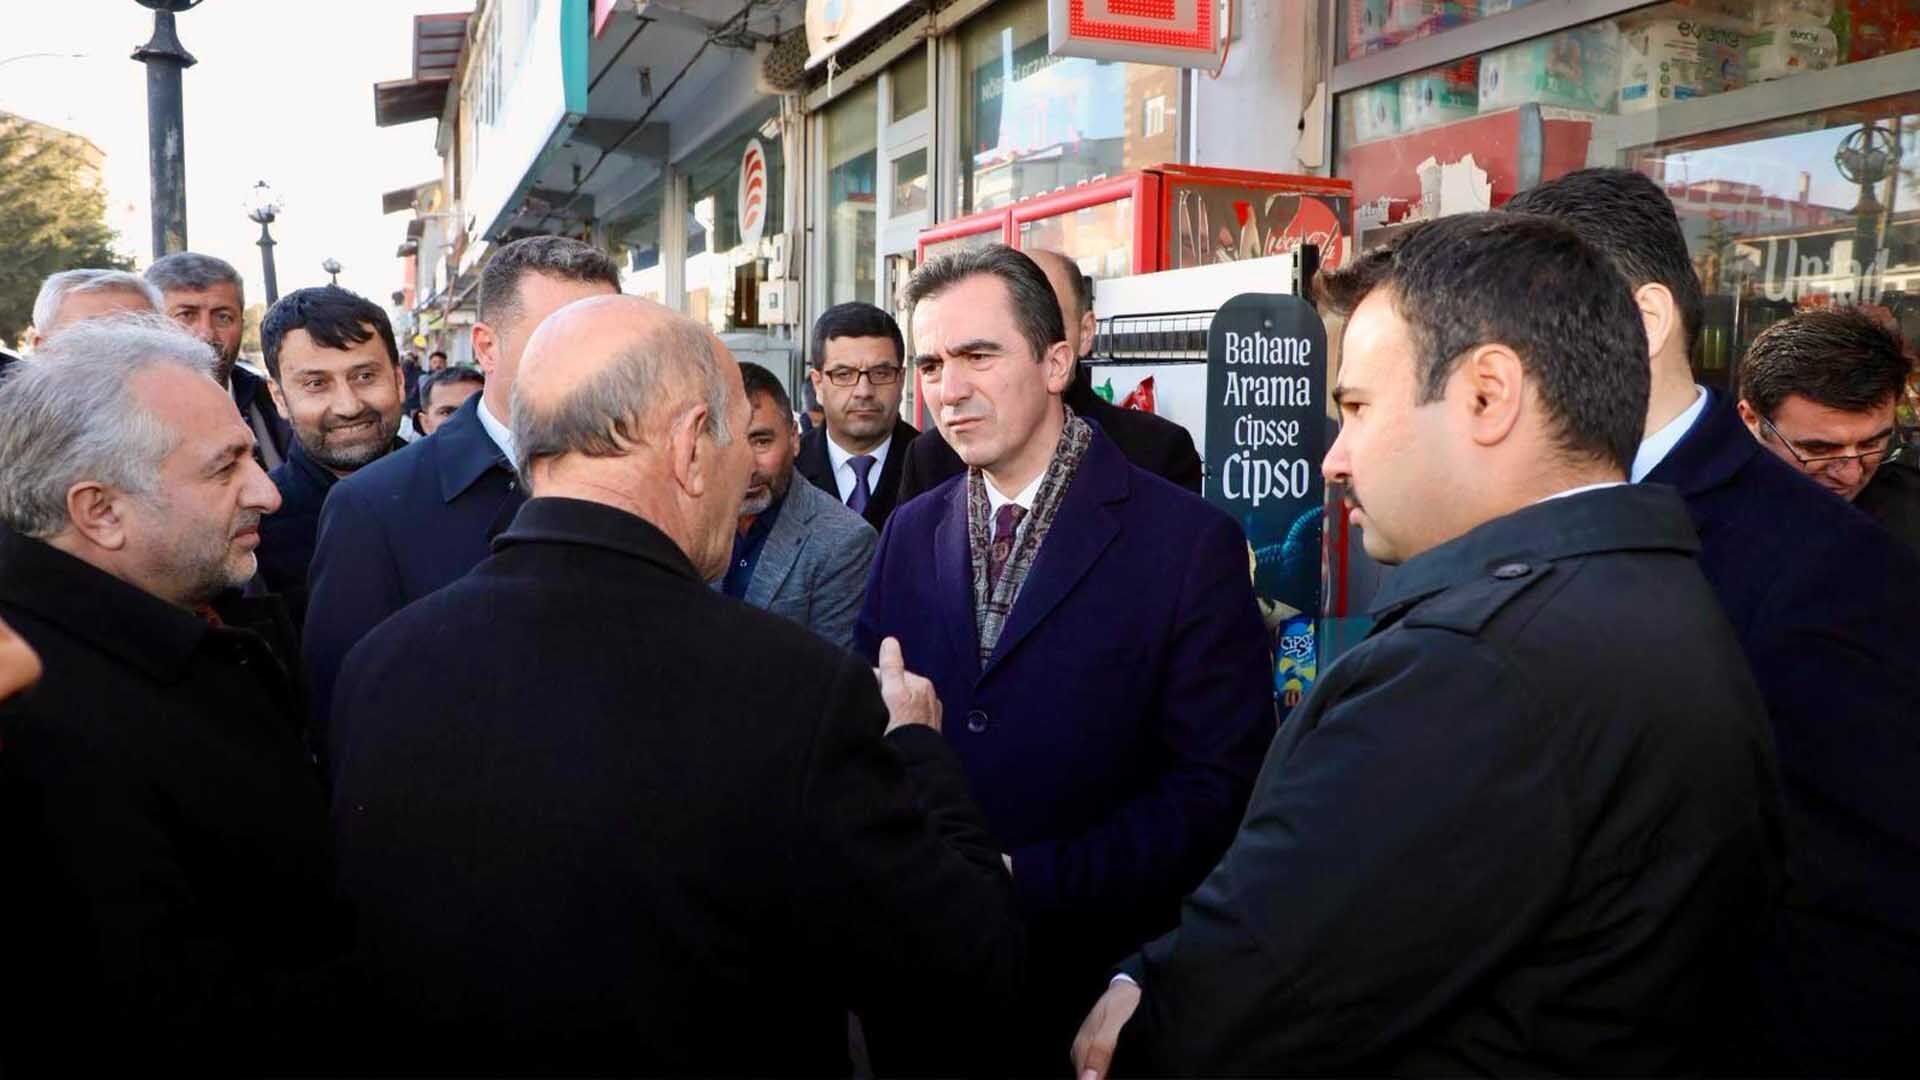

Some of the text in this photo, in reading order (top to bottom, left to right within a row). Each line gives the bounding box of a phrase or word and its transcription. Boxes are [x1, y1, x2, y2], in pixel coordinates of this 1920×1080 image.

[1225, 331, 1311, 366] Bahane
[1224, 371, 1311, 406] Arama
[1234, 413, 1300, 451] Cipsse
[1222, 449, 1309, 507] Cipso
